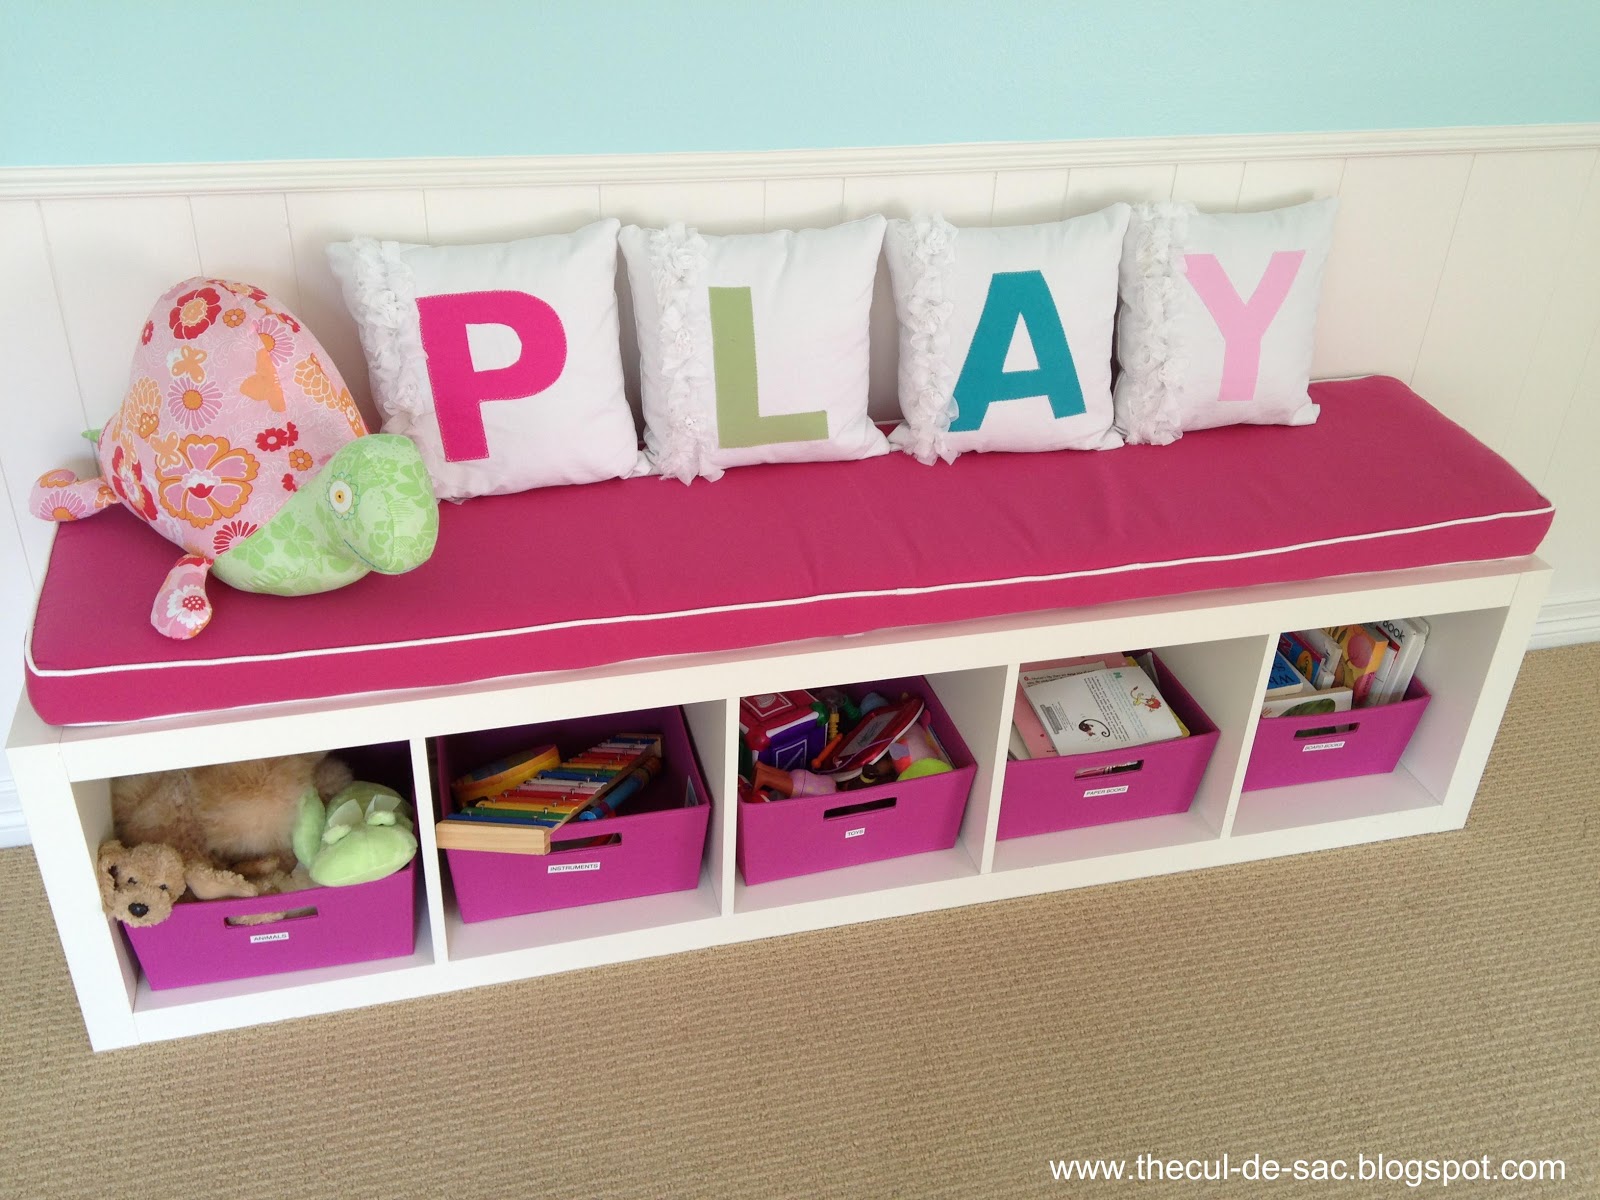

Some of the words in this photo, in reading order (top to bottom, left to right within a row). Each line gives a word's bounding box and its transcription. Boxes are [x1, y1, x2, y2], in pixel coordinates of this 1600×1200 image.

[1106, 786, 1127, 794] BOOKS
[848, 828, 864, 837] TOYS
[550, 863, 599, 872] INSTRUMENTS
[253, 933, 287, 942] ANIMALS
